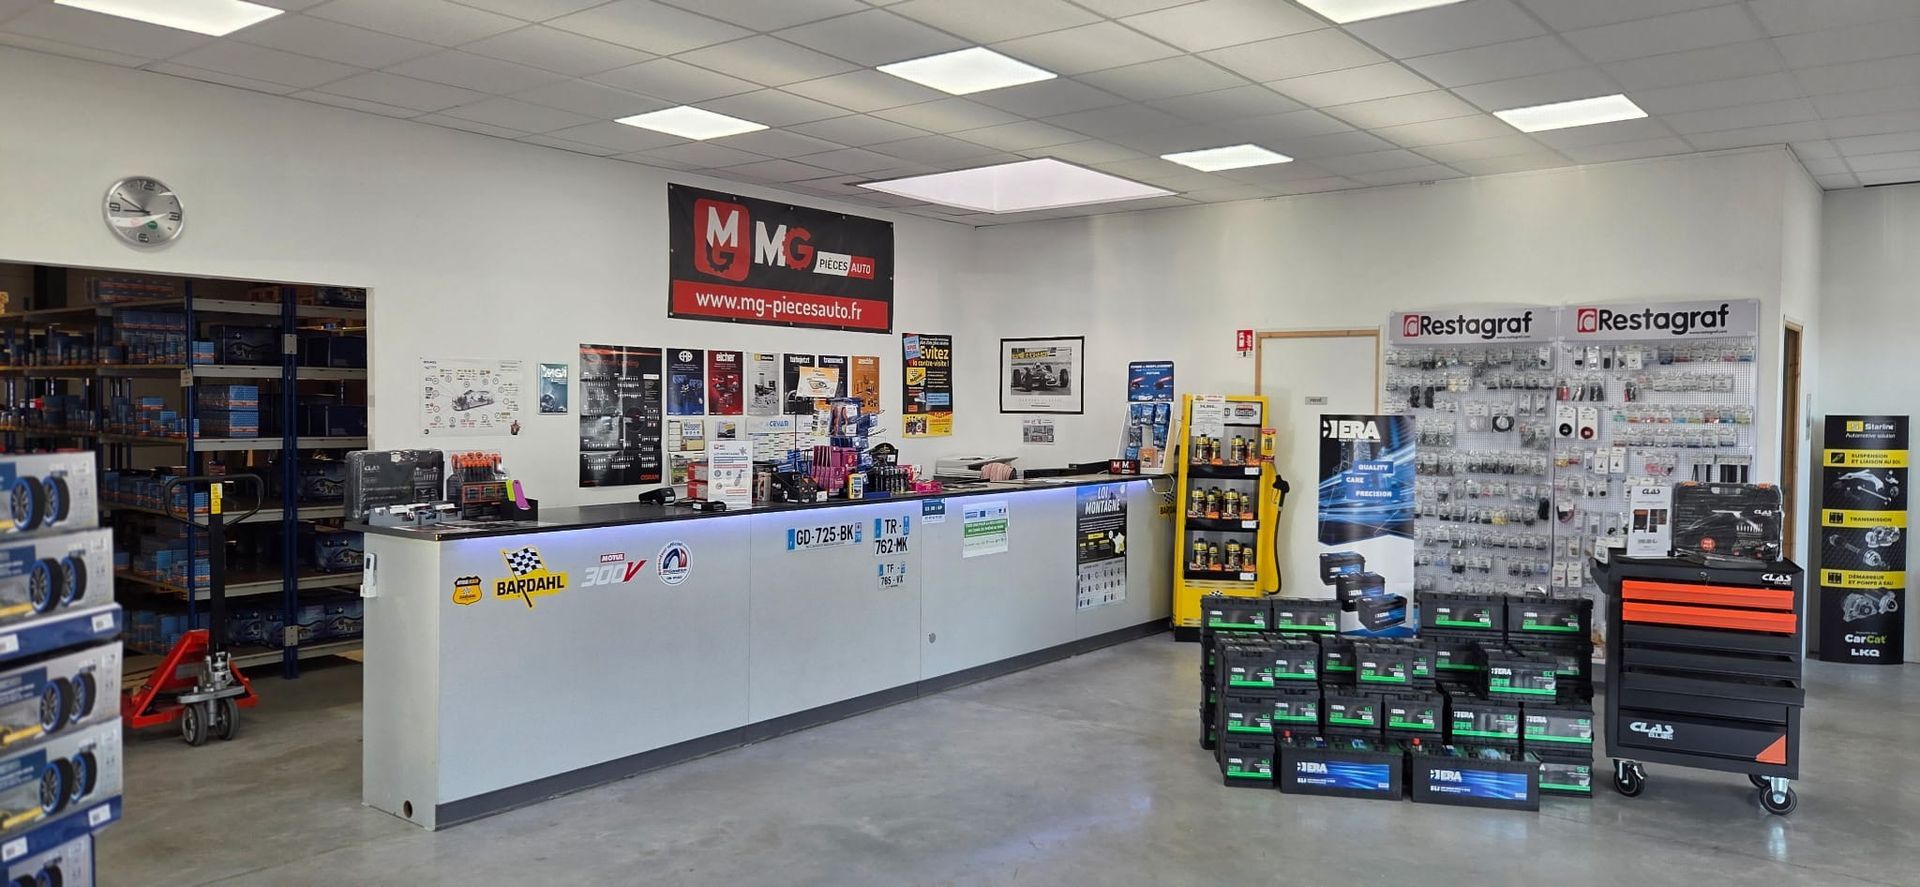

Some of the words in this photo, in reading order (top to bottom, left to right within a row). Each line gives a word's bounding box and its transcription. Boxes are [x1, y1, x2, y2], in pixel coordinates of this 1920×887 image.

[754, 220, 815, 271] MG
[850, 262, 871, 275] AUTO
[695, 291, 862, 321] www.mg-piecesauto.fr
[1419, 310, 1533, 340] Restagraf
[1598, 303, 1729, 336] Restagraf
[1097, 486, 1109, 499] LOI
[1641, 487, 1661, 495] CLAS
[1085, 498, 1120, 515] MONTAGNE
[796, 524, 854, 545] GD-725-BK
[874, 536, 908, 554] 762-MK
[580, 560, 648, 588] 300V
[1761, 573, 1792, 582] CLAS
[497, 575, 565, 596] BARDAHL
[1844, 633, 1886, 644] CarCat
[1850, 648, 1880, 657] LKQ
[1629, 721, 1674, 734] CLAS
